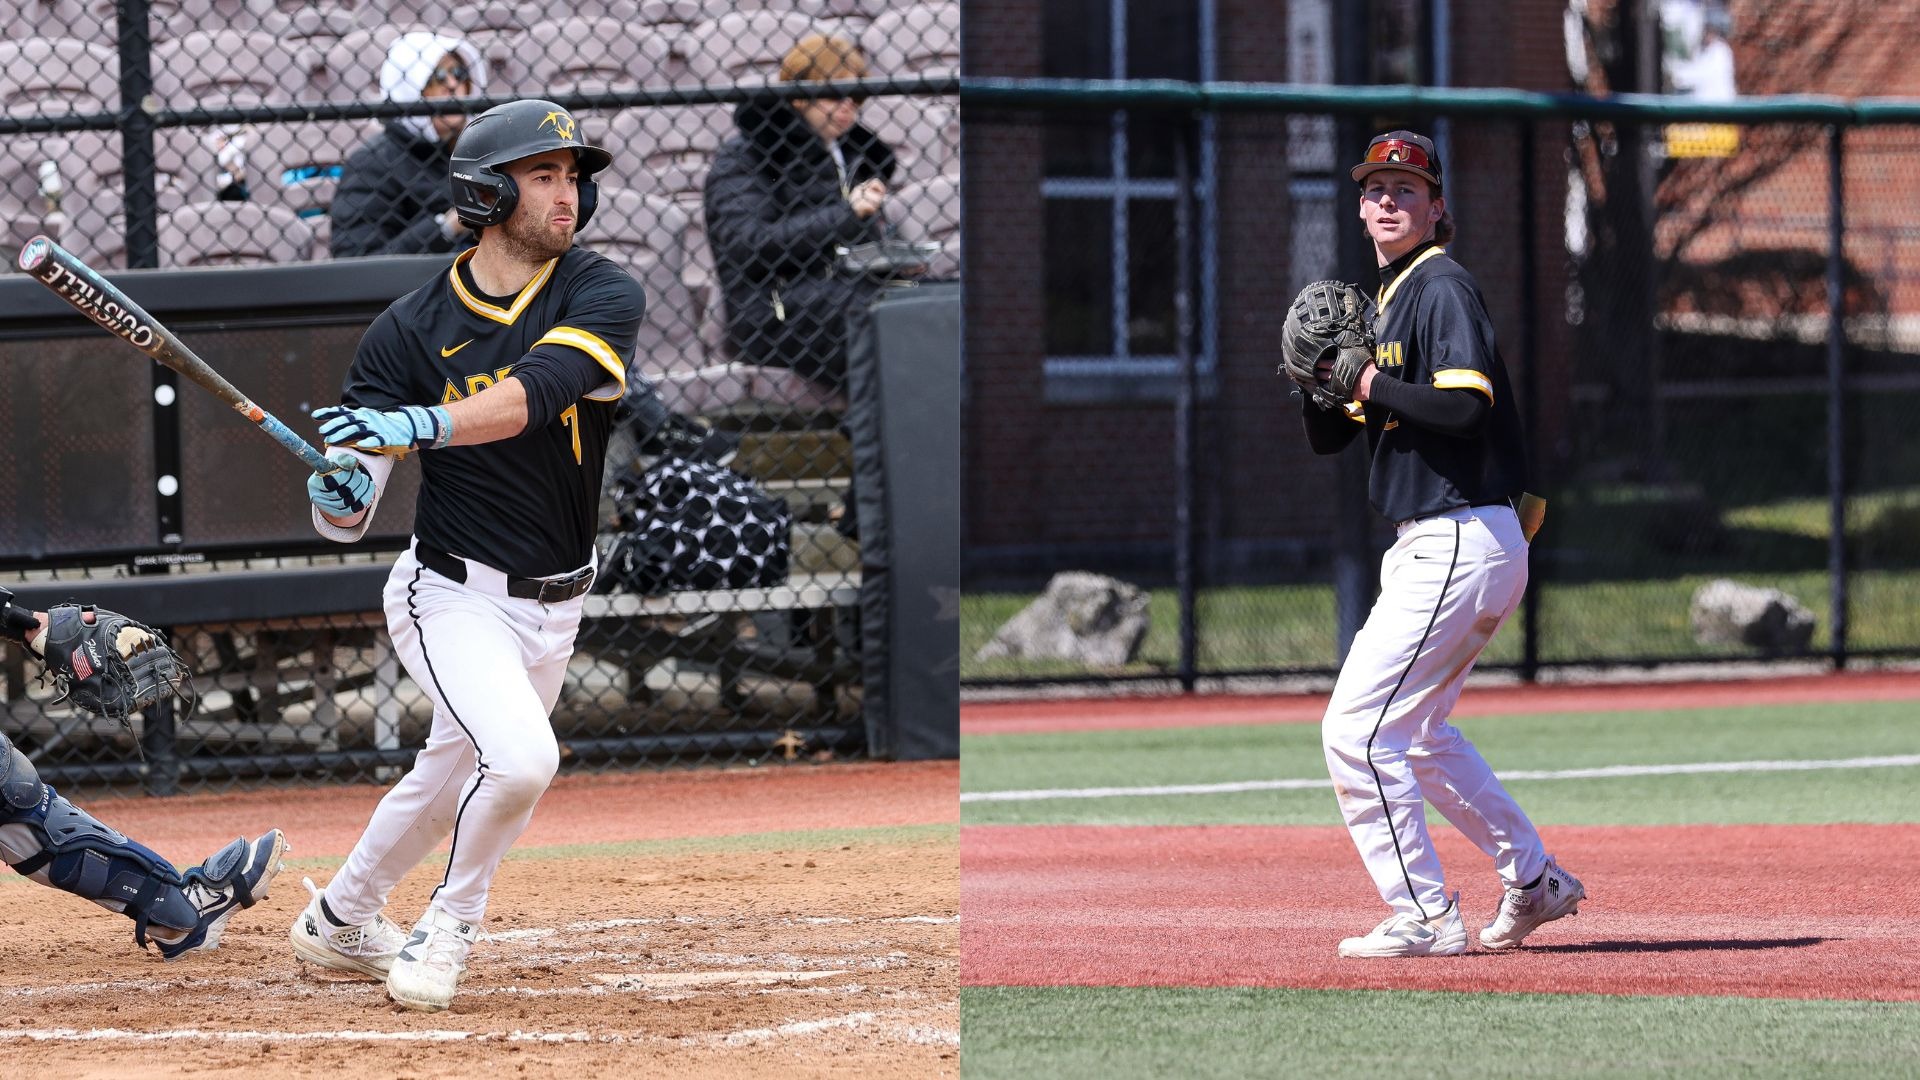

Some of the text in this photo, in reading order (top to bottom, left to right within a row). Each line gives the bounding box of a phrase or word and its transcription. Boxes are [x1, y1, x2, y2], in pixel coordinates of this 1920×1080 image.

[41, 261, 165, 349] LOUISVILLE
[1376, 341, 1404, 367] HI
[560, 403, 582, 466] 7
